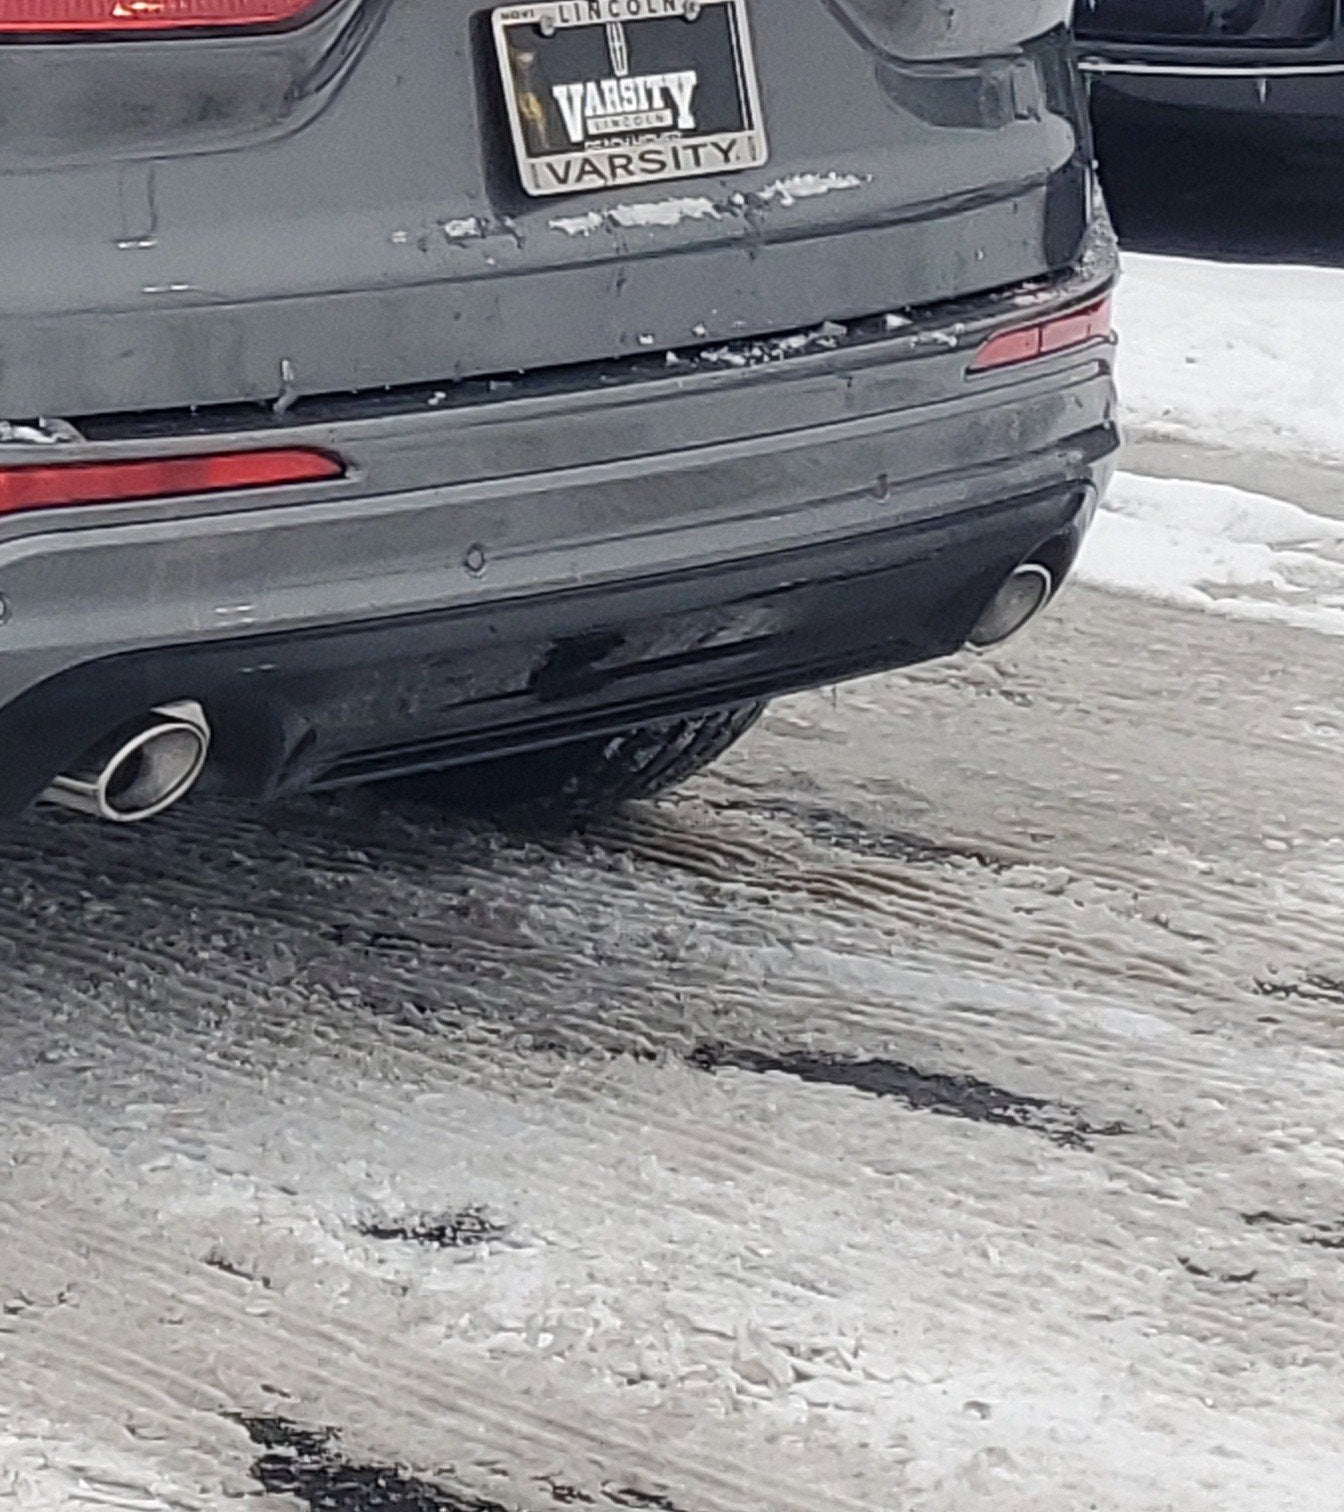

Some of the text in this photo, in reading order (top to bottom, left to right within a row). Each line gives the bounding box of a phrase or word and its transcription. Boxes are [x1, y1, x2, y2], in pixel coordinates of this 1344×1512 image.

[552, 70, 698, 143] VARSITY
[594, 113, 665, 131] LINCOLN
[546, 139, 736, 185] VARSITY
